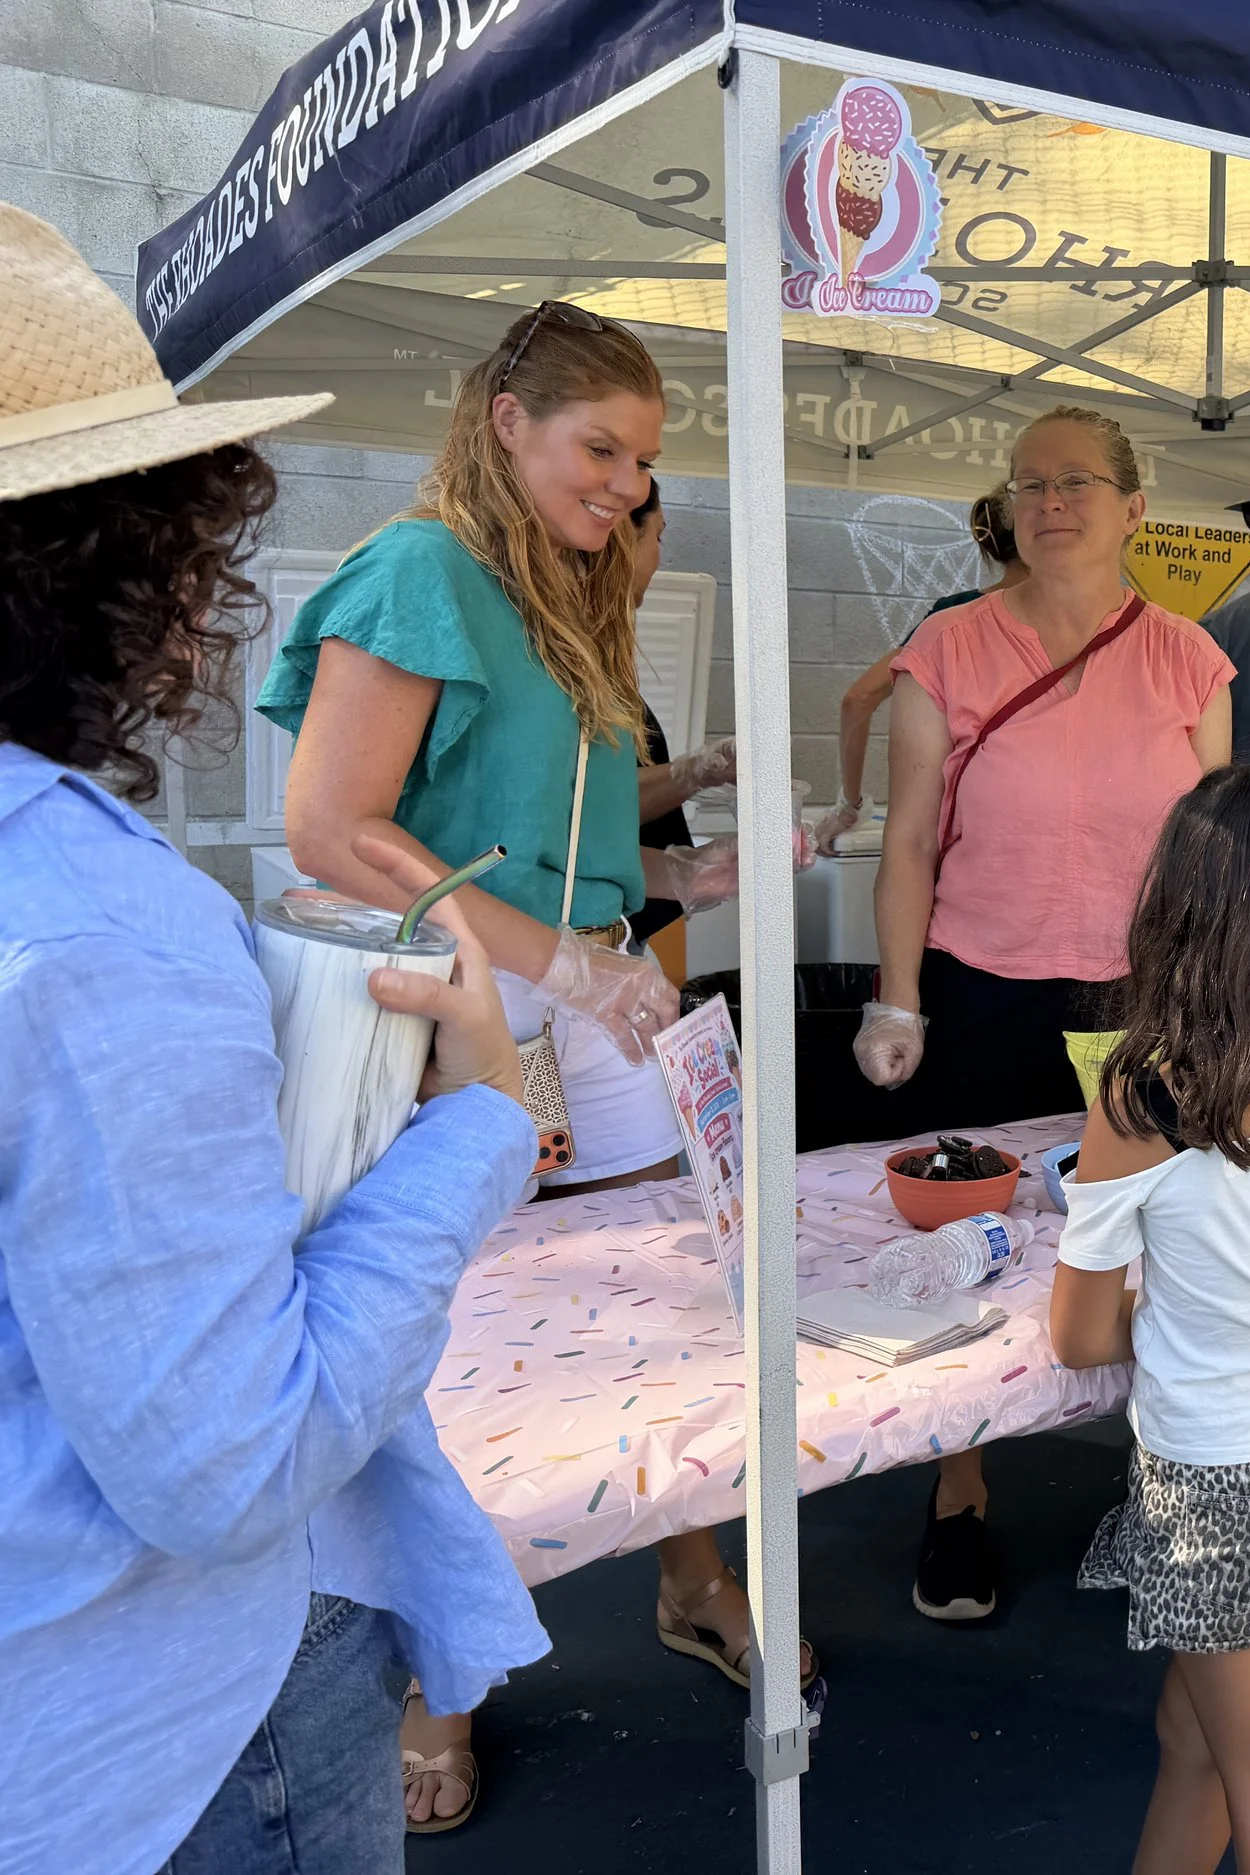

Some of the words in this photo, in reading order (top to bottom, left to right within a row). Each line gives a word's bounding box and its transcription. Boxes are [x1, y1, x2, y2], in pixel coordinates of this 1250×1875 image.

[265, 0, 521, 222] FOUNDATI
[820, 273, 848, 311] Ice
[1135, 541, 1151, 556] at
[1155, 540, 1198, 560] Work
[1202, 548, 1232, 563] and
[1167, 563, 1202, 586] Play
